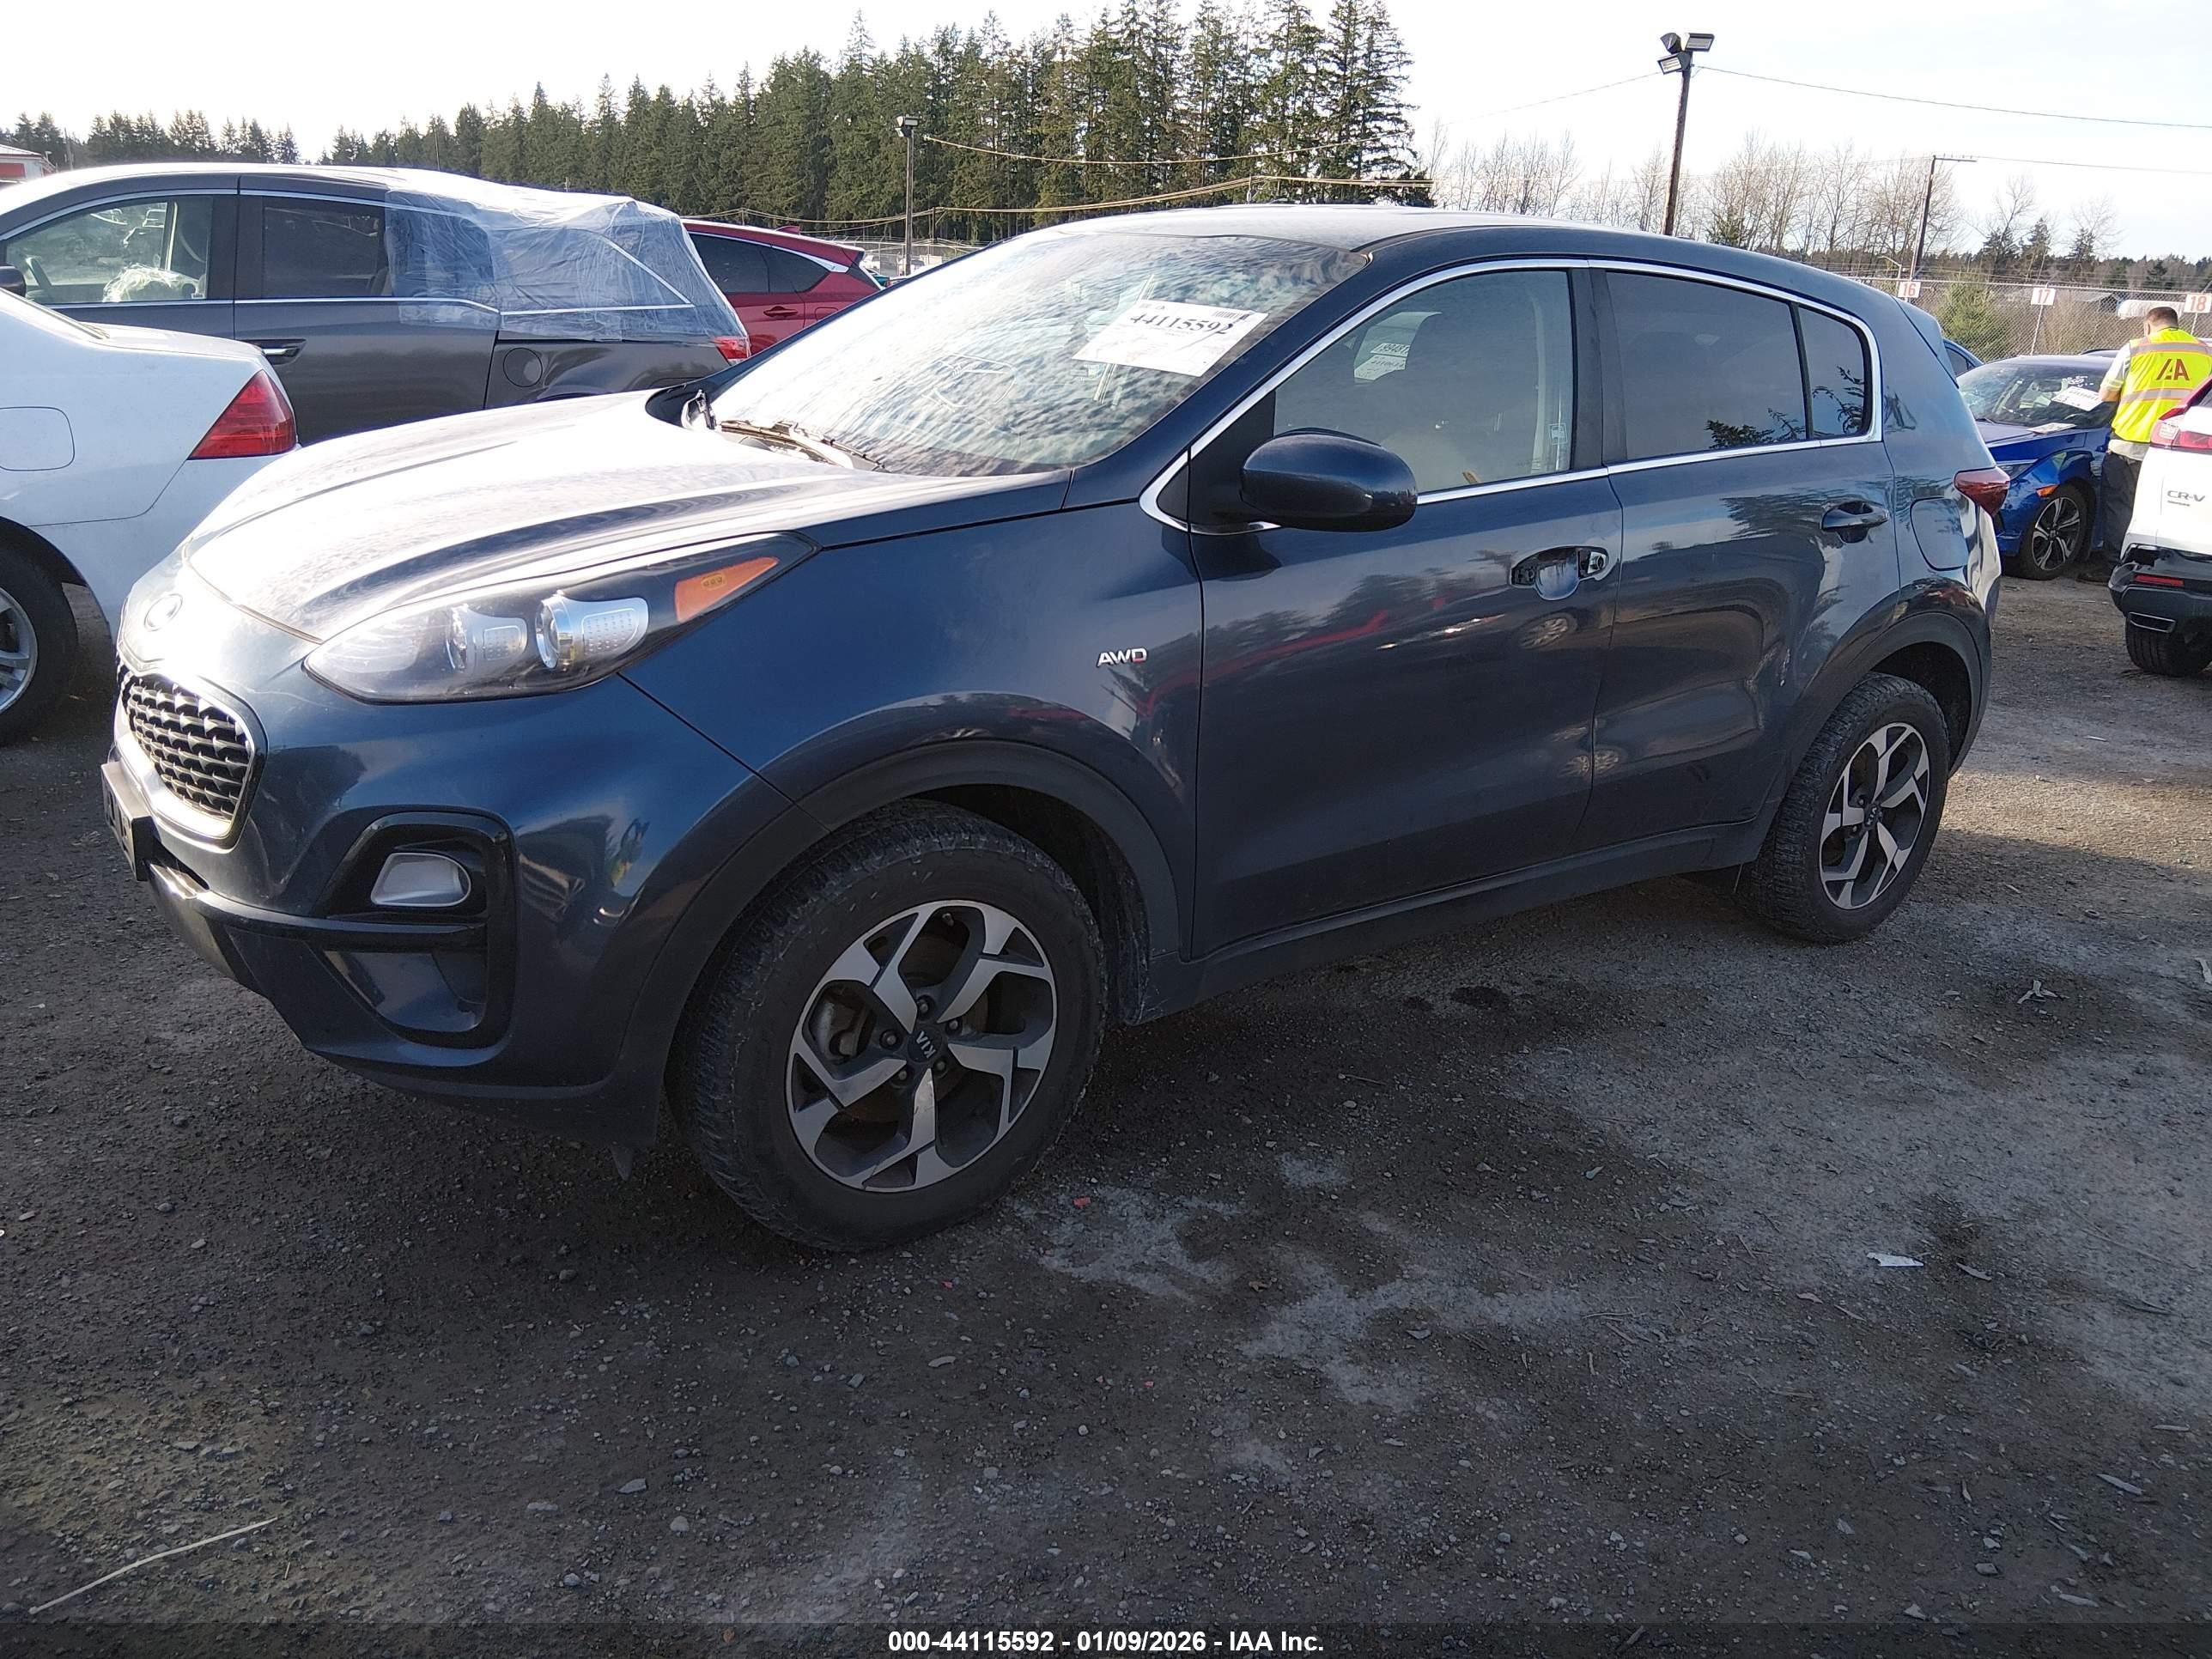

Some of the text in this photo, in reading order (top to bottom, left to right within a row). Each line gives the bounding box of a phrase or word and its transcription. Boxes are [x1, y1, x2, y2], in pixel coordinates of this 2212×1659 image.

[1898, 280, 1917, 297] 16
[2037, 289, 2051, 304] 17
[2191, 295, 2207, 312] 18
[1130, 313, 1234, 334] 44115592
[2166, 489, 2206, 502] CR-V
[1096, 647, 1148, 667] AWD
[916, 1030, 936, 1058] KIA
